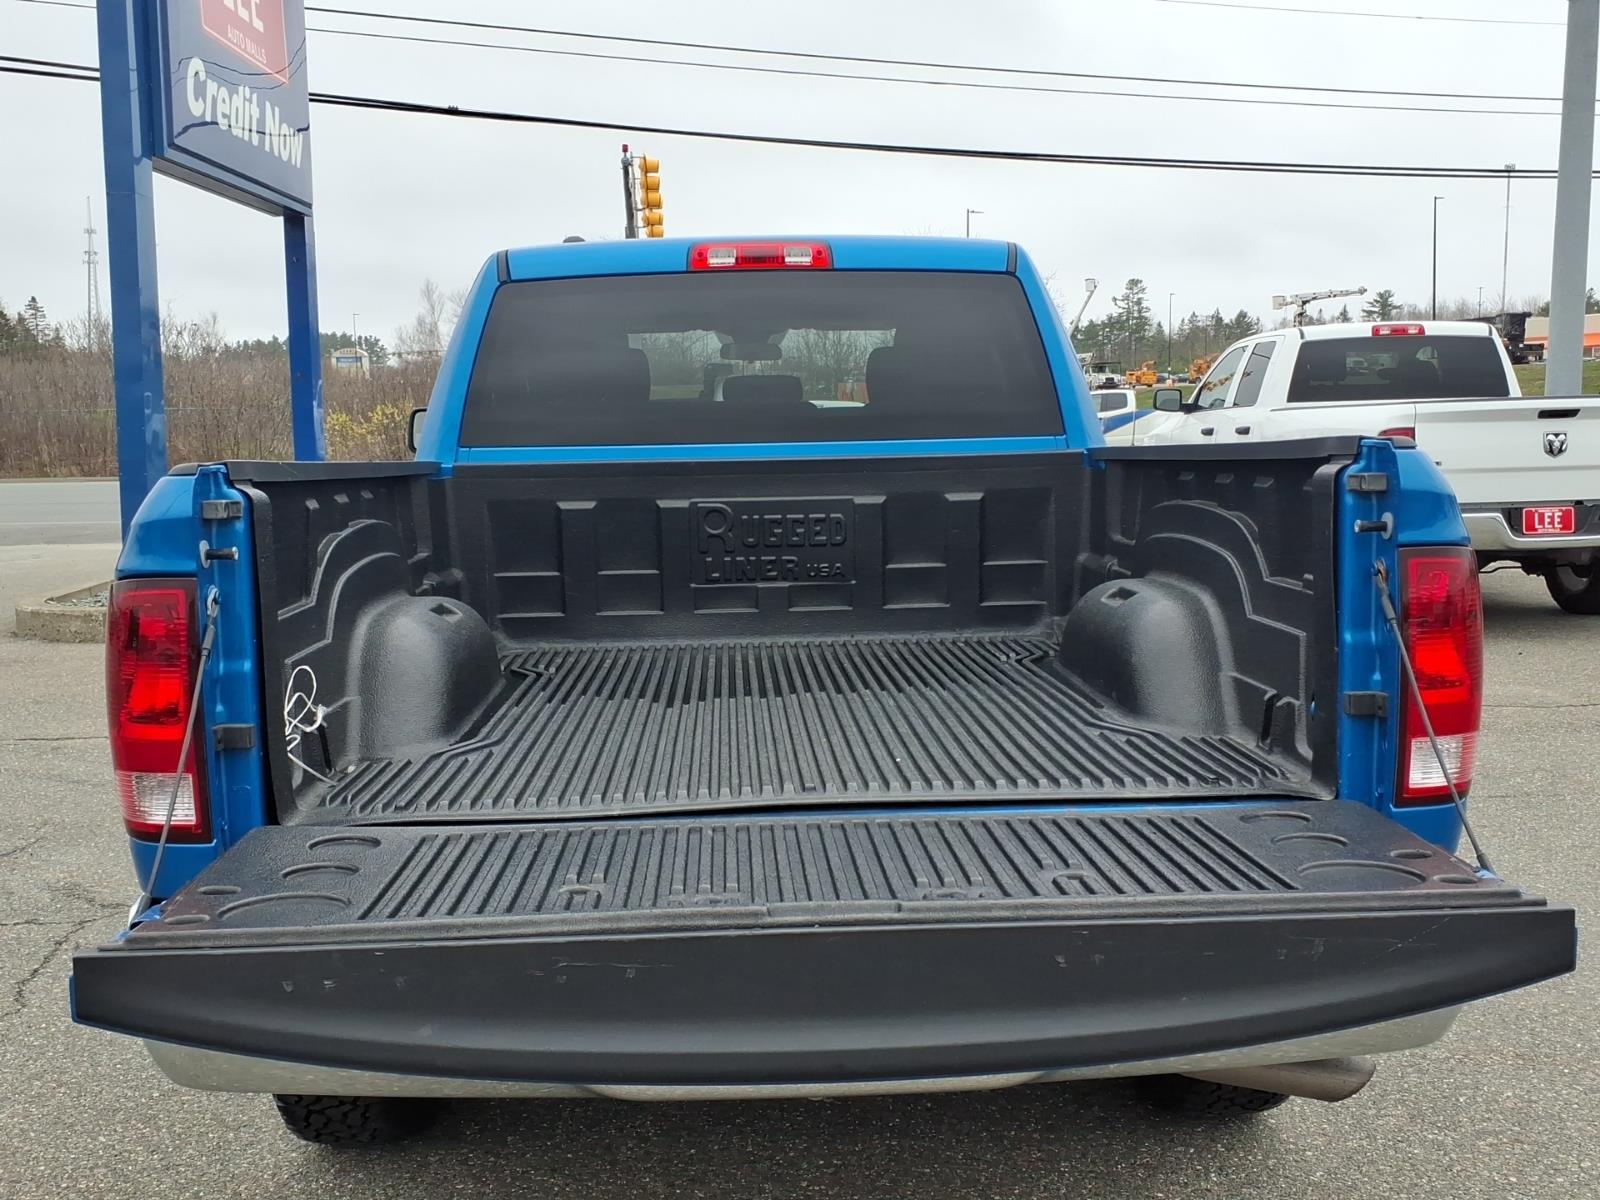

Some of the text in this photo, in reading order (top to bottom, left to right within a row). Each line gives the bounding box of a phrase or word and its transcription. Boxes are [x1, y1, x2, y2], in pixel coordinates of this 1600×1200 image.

[227, 24, 267, 64] AUTO MALLS
[187, 57, 303, 168] Credit Now
[697, 503, 847, 553] RUGGED
[1534, 512, 1563, 529] LEE
[705, 556, 846, 582] LINER USA
